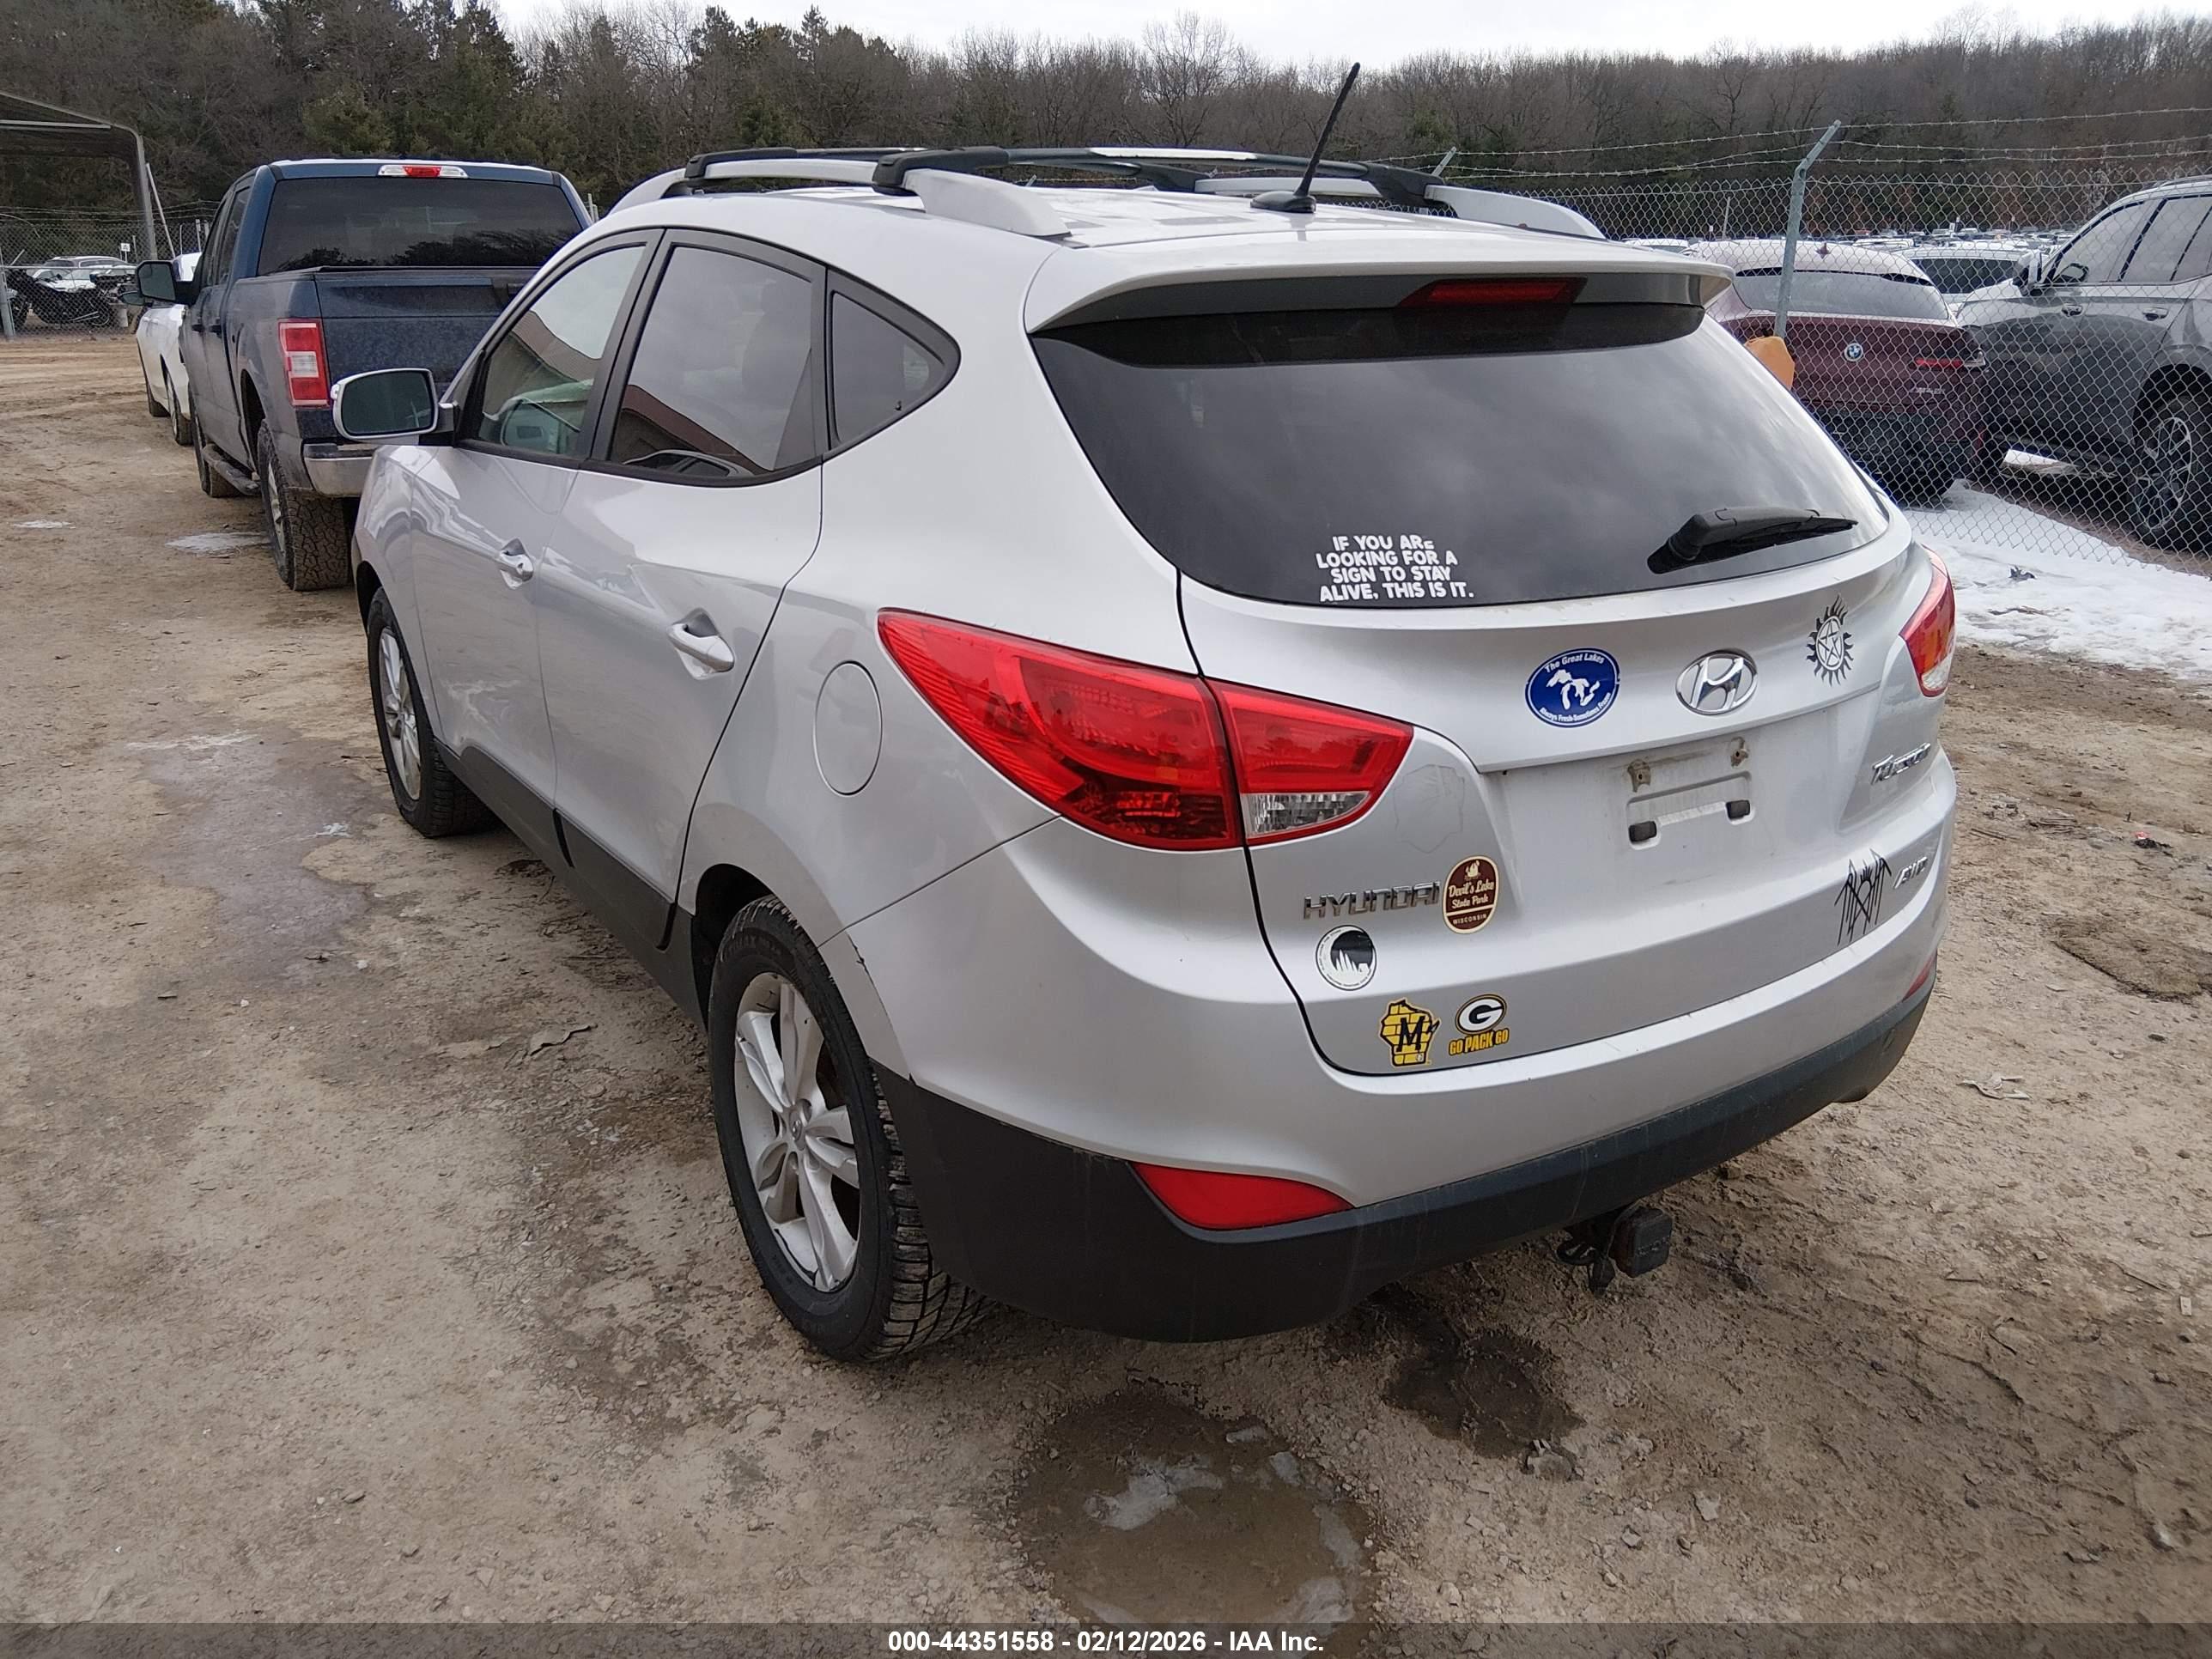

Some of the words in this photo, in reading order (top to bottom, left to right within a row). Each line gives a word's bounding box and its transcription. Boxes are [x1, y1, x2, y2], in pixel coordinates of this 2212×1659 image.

[1333, 536, 1349, 551] IF
[1353, 535, 1393, 550] YOU
[1316, 550, 1398, 568] LOOKING
[1401, 550, 1439, 565] FOR
[1445, 550, 1458, 565] A
[1330, 566, 1376, 584] SIGN
[1379, 566, 1406, 581] TO
[1411, 565, 1451, 581] STAY
[1320, 583, 1379, 602] ALIVE,
[1382, 582, 1425, 599] THIS
[1428, 581, 1447, 598] IS
[1449, 581, 1474, 598] IT.
[1545, 661, 1560, 673] The
[1561, 653, 1583, 665] Great
[1583, 653, 1605, 664] Lakes
[1449, 881, 1474, 898] Devil's
[1475, 878, 1494, 893] Lake
[1303, 881, 1441, 920] HYUNDAI
[1451, 898, 1470, 909] State
[1471, 893, 1488, 906] Park
[1453, 913, 1486, 925] WISCONSIN
[1449, 1039, 1464, 1056] GO
[1464, 1031, 1494, 1054] PACK
[1495, 1028, 1510, 1045] GO
